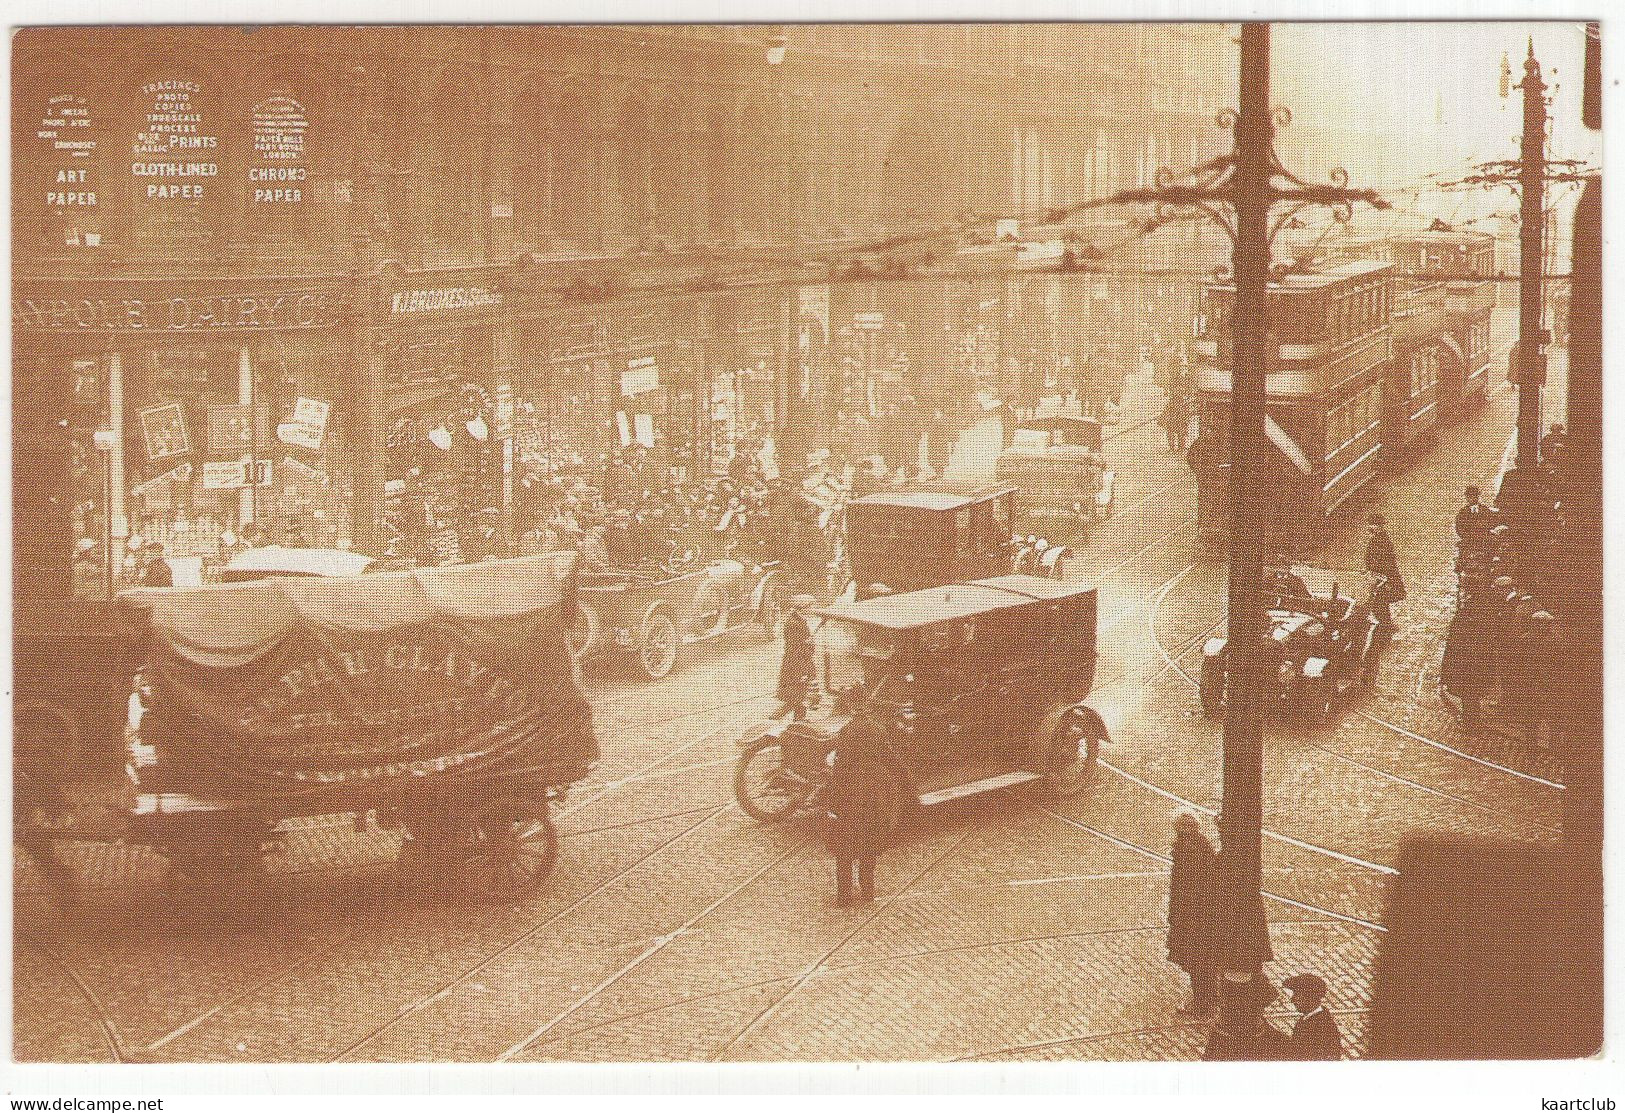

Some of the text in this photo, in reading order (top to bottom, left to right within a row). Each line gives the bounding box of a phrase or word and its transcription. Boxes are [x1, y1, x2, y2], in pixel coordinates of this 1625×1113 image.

[169, 134, 217, 148] PRINTS
[56, 170, 87, 183] ART
[131, 162, 218, 177] CLOTH-LINED
[47, 191, 97, 205] PAPER
[146, 184, 203, 198] PAPER
[254, 189, 302, 202] PAPER
[166, 296, 284, 330] DAIRY
